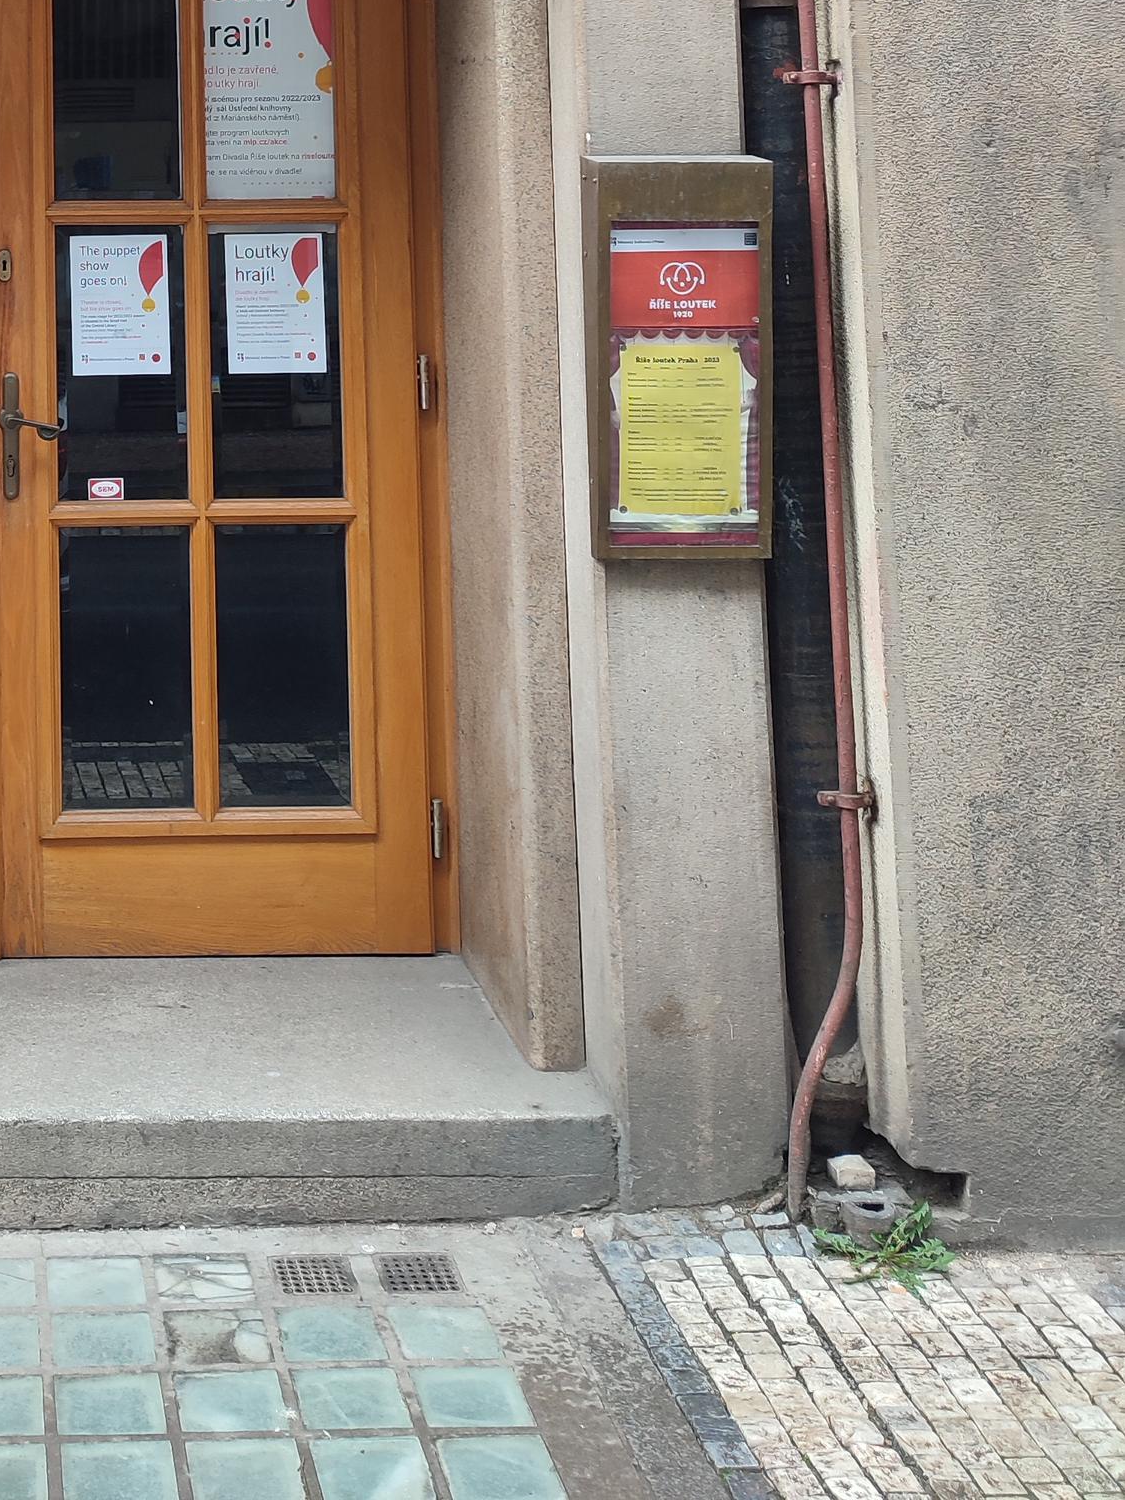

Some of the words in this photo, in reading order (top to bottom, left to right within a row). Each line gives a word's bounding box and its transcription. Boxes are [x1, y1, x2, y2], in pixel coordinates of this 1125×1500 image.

[209, 17, 272, 55] rají!
[79, 245, 100, 256] The
[103, 246, 140, 258] puppet
[235, 243, 289, 262] Loutky
[80, 261, 109, 271] show
[235, 265, 275, 285] hrají!
[80, 277, 107, 288] goes
[110, 276, 127, 286] on!
[649, 298, 671, 310] ŘÍŠE
[673, 299, 717, 309] LOUTEK
[673, 310, 694, 318] 1920
